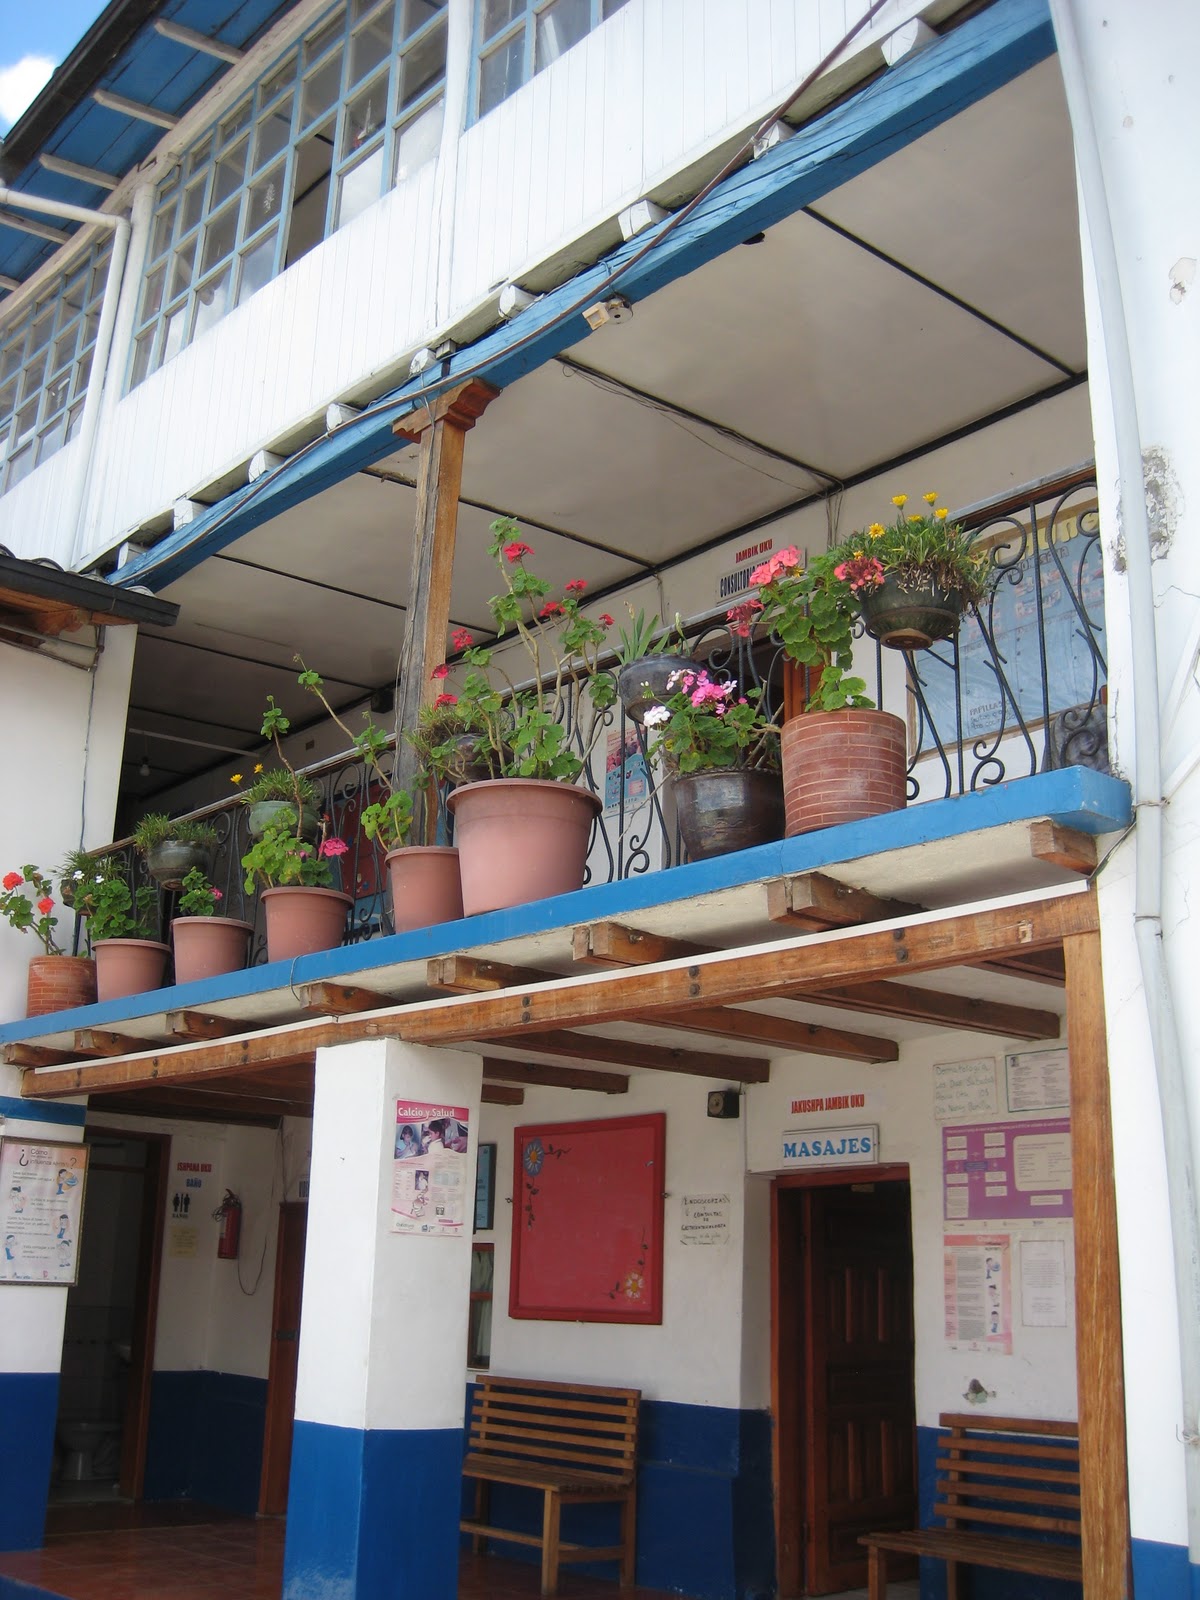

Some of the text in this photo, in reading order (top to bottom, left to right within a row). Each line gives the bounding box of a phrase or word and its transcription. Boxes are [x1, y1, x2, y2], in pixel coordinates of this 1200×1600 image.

[759, 538, 773, 554] UKU
[825, 1095, 850, 1111] JAMBIK
[850, 1093, 865, 1108] UKU
[398, 1106, 455, 1119] Calcio y Salud
[783, 1137, 871, 1158] MASAJES
[186, 1178, 202, 1188] BAÑO
